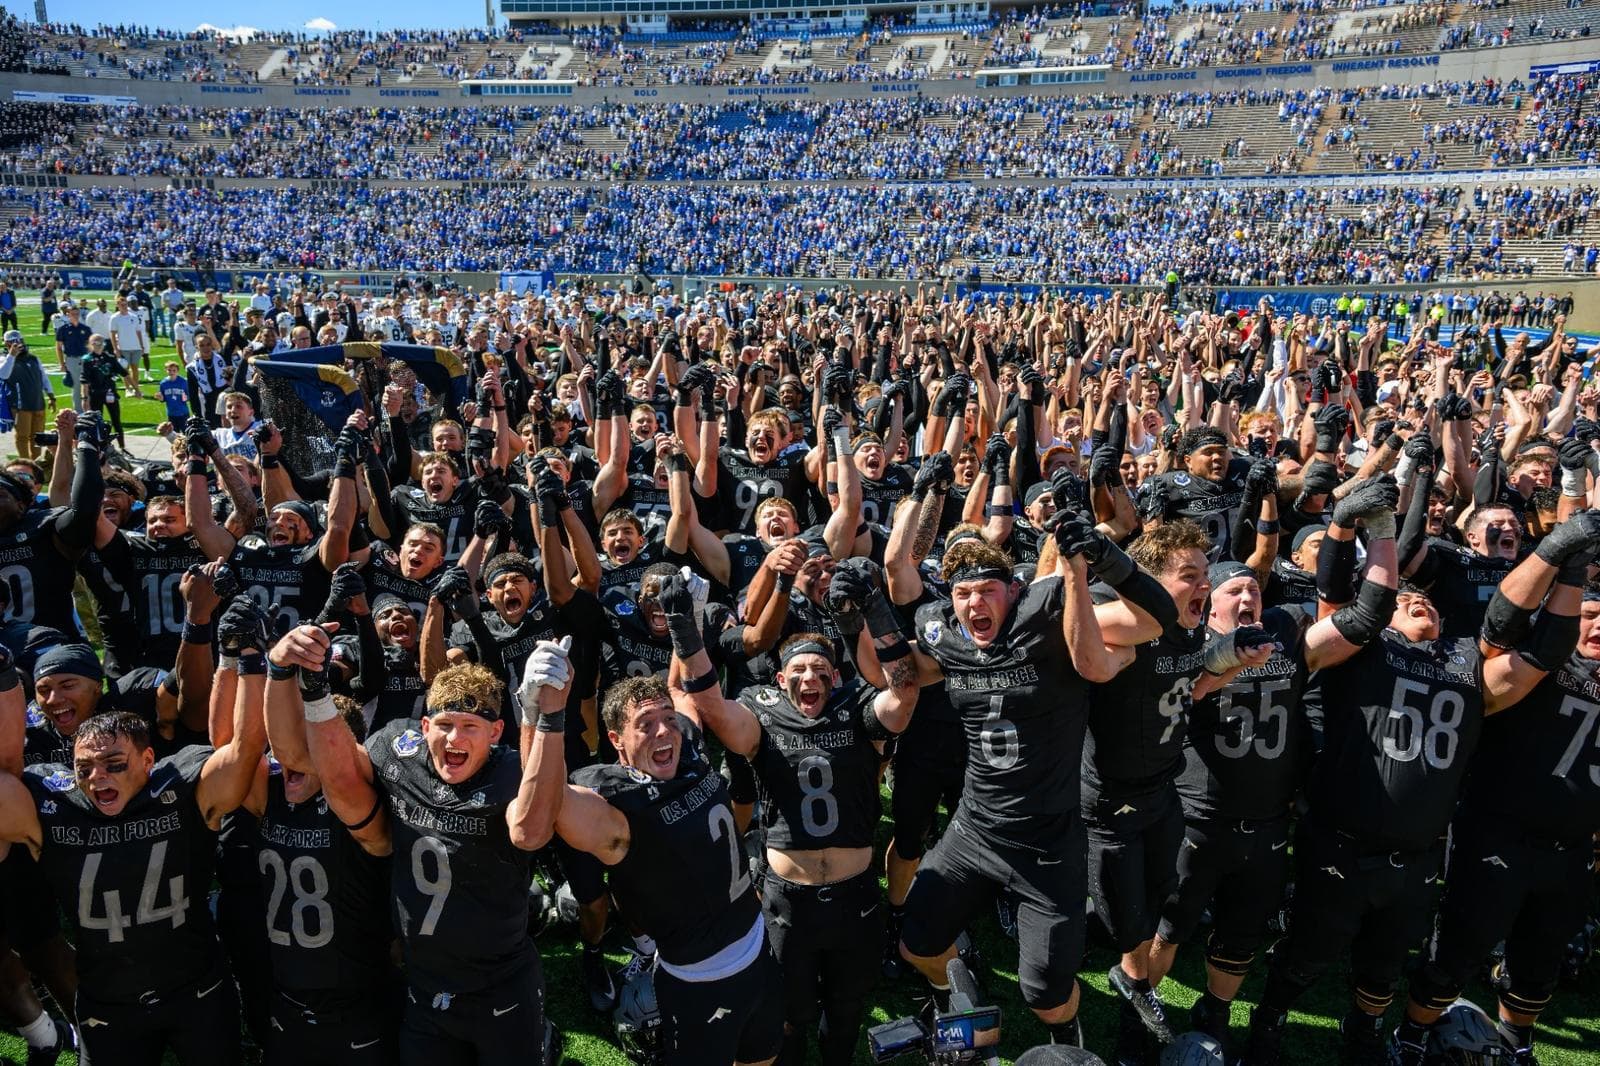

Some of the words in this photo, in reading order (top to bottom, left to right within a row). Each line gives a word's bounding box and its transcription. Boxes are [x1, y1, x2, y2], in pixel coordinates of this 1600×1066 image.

[1130, 74, 1162, 82] ALLIED
[1164, 71, 1197, 80] FORCE
[1215, 68, 1262, 78] ENDURING
[1266, 65, 1312, 76] FREEDOM
[1332, 60, 1385, 72] INHERENT
[1388, 56, 1440, 68] RESOLVE
[201, 85, 231, 93] BERLIN
[233, 86, 263, 94] AIRLIFT
[294, 88, 344, 96] LINEBACKER
[380, 89, 411, 97] DESERT
[412, 89, 439, 97] STORM
[634, 89, 658, 97] BOLO
[728, 87, 771, 96] MIDNIGHT
[772, 87, 809, 95] HAMMER
[872, 84, 888, 92] MIG
[891, 83, 920, 91] ALLEY
[141, 573, 186, 636] 10
[950, 676, 967, 691] U.S.
[969, 673, 989, 691] AIR
[991, 664, 1039, 689] FORCE
[1385, 651, 1409, 674] U.S.
[1411, 660, 1435, 681] AIR
[1437, 669, 1477, 687] FORCE
[1557, 670, 1580, 692] U.S.
[980, 695, 1020, 769] 6
[1214, 678, 1292, 760] 55
[1382, 676, 1465, 770] 58
[812, 729, 856, 750] FORCE
[797, 755, 840, 838] 8
[410, 805, 435, 829] AIR
[435, 811, 488, 836] FORCE
[660, 800, 687, 825] U.S.
[51, 826, 84, 846] U.S.
[88, 825, 120, 846] AIR
[124, 812, 181, 841] FORCE
[269, 824, 289, 845] AIR
[287, 828, 331, 848] FORCE
[708, 802, 752, 903] 2
[78, 839, 190, 943] 44
[411, 835, 452, 936] 9
[258, 849, 334, 949] 28
